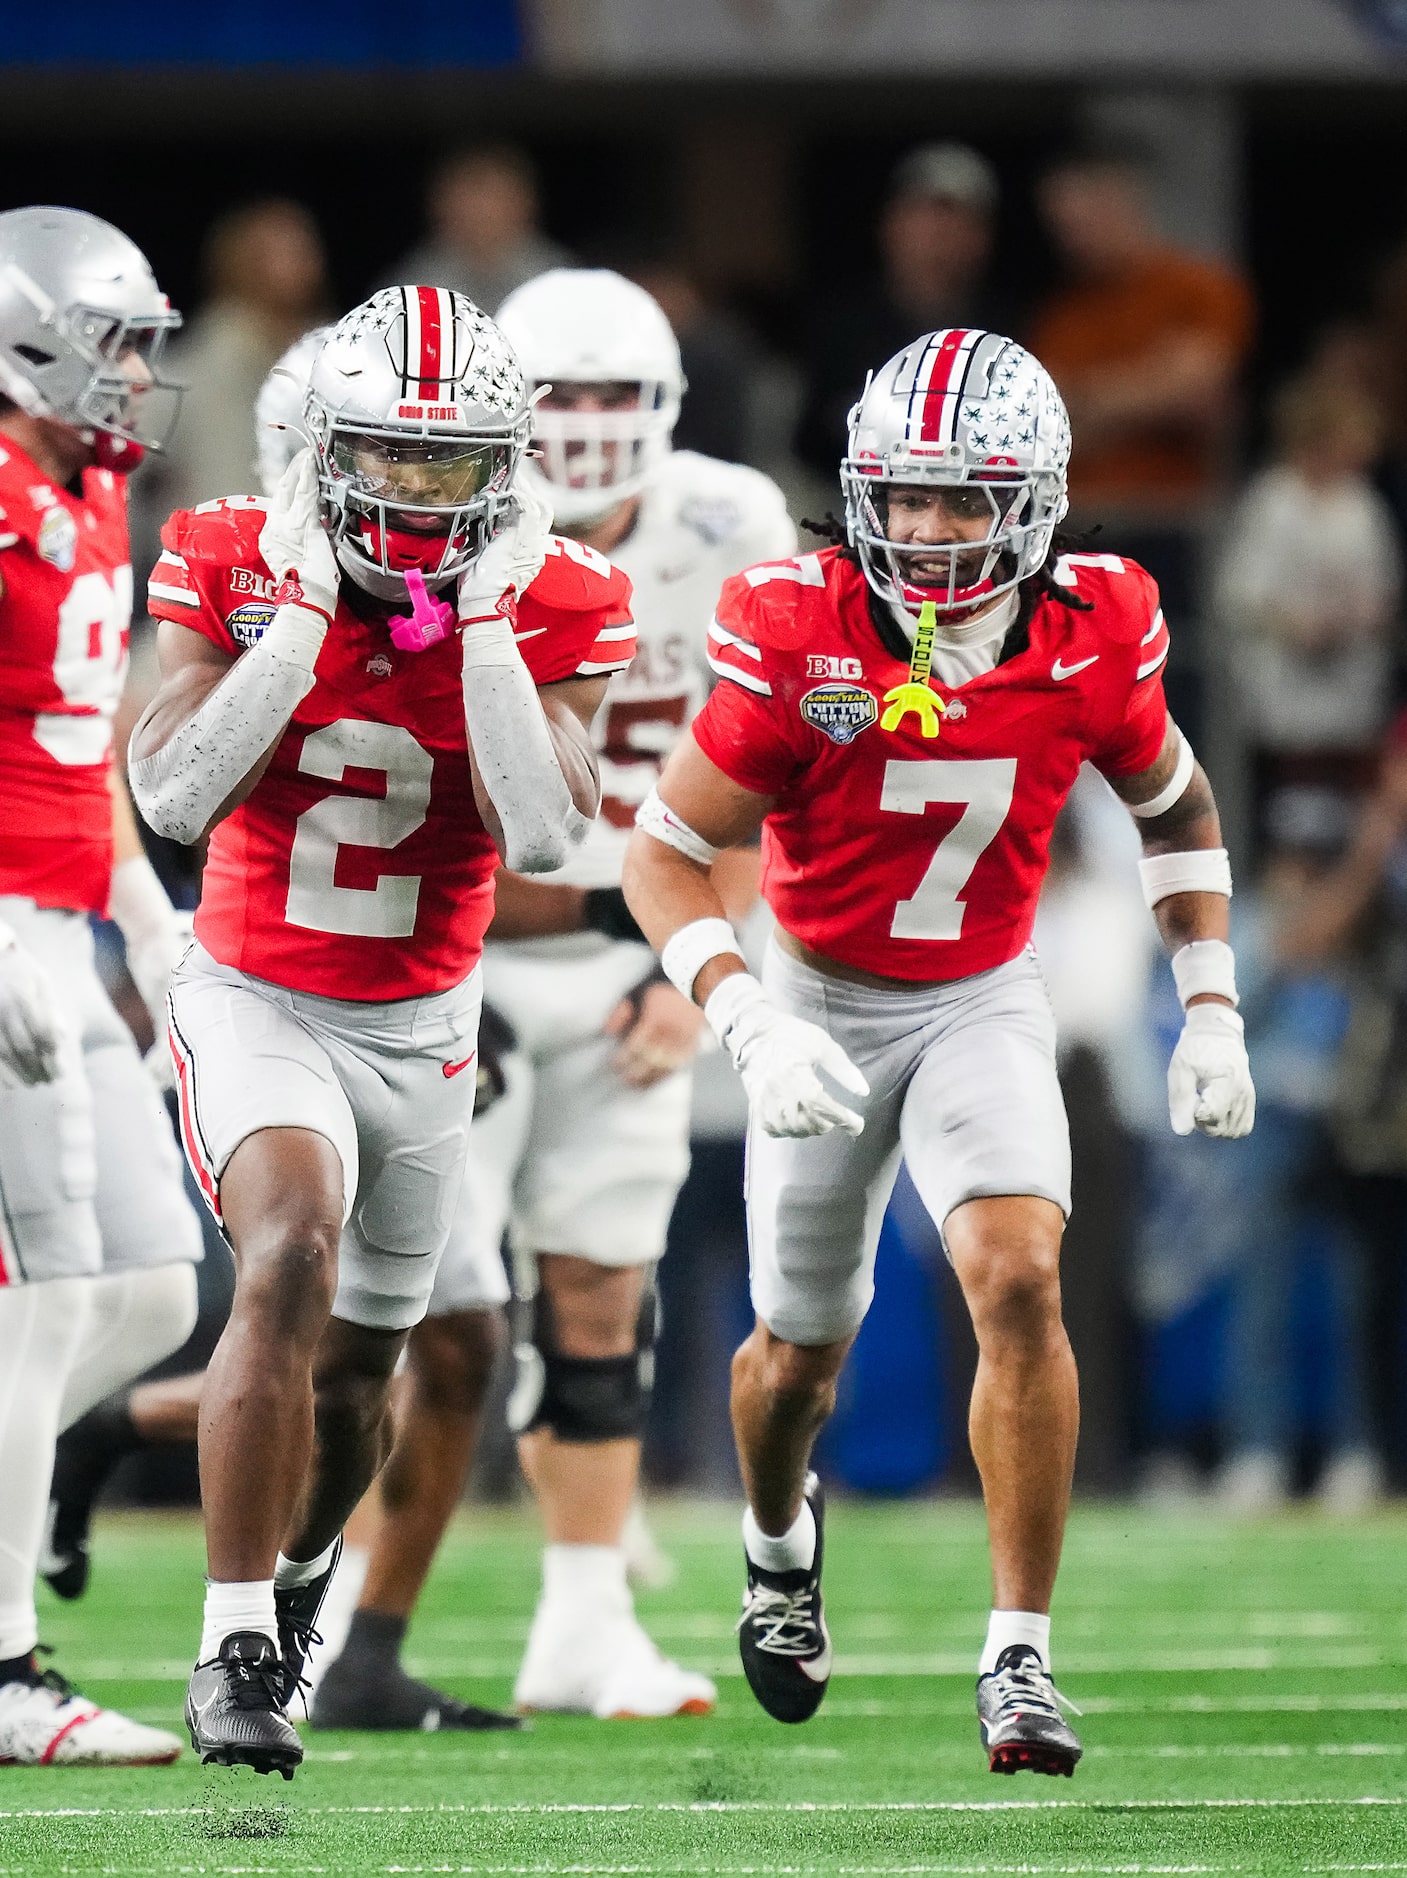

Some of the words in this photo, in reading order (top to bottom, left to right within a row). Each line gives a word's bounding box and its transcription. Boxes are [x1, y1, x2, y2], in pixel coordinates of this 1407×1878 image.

[398, 405, 424, 419] OHIO
[427, 407, 458, 421] STATE
[232, 623, 270, 642] COTT
[909, 626, 935, 686] SHOCK
[807, 702, 872, 721] COTTON
[284, 717, 435, 938] 2
[879, 758, 1018, 941] 7
